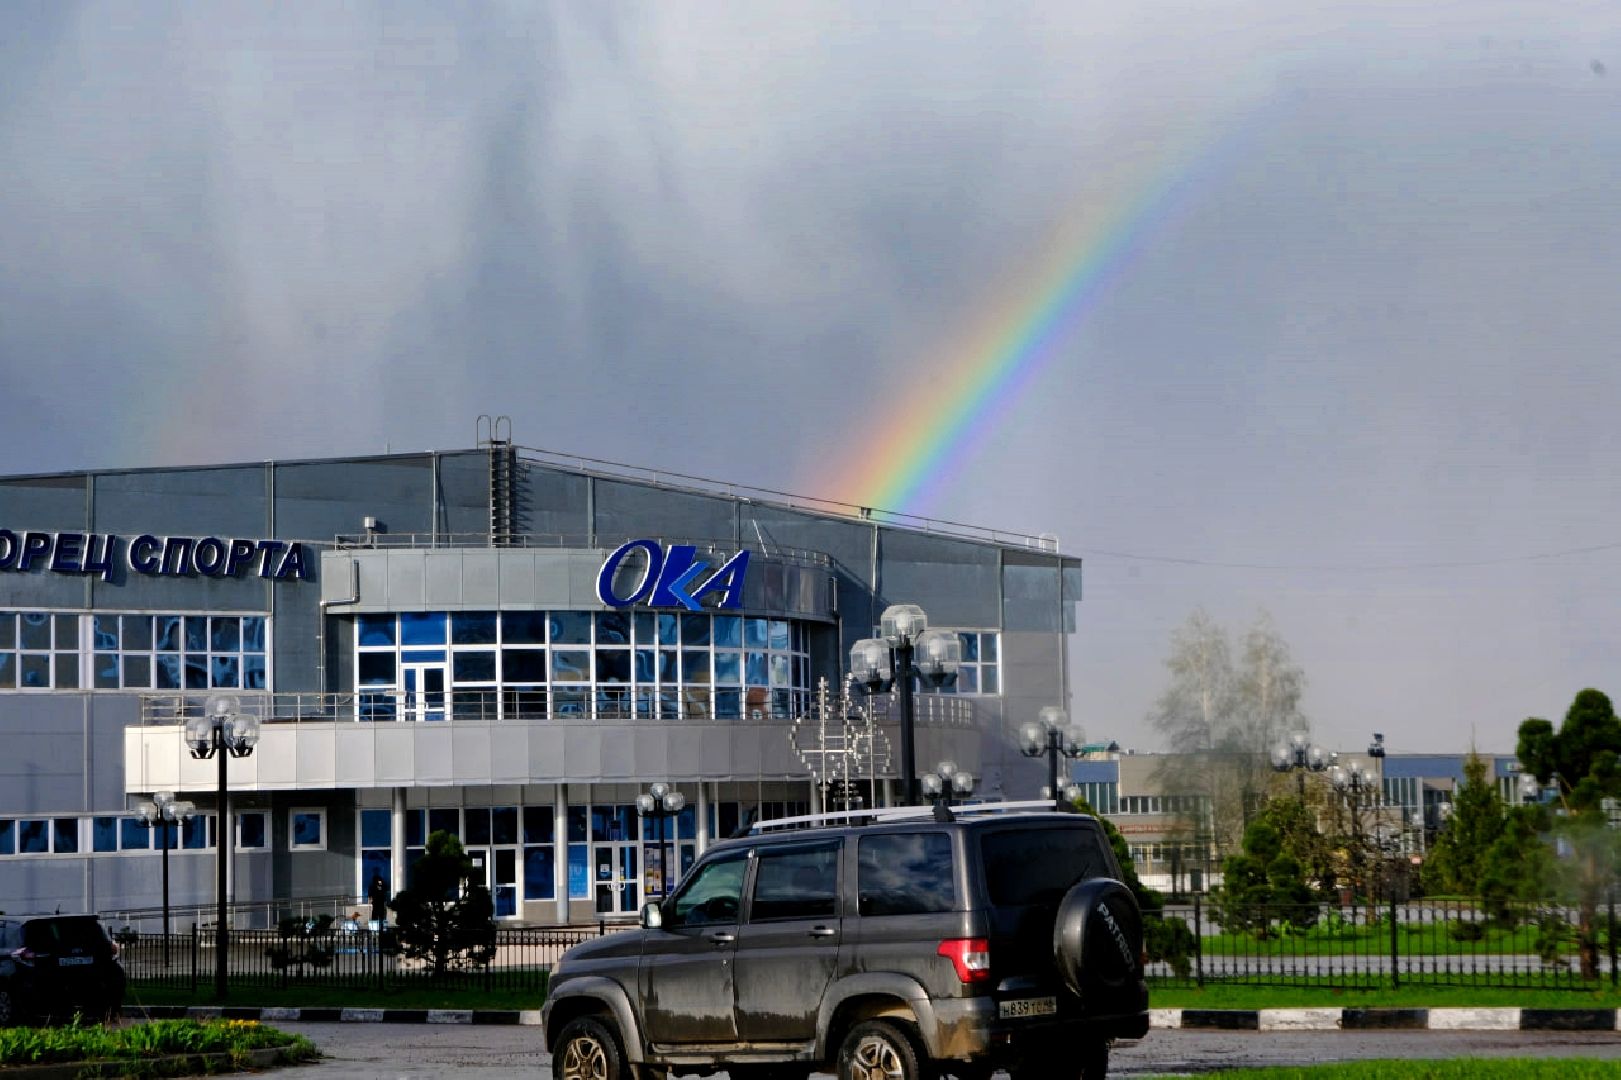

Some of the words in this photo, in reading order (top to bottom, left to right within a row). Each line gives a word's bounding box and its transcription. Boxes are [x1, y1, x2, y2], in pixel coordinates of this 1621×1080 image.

[127, 534, 306, 578] СПОРТА
[596, 539, 750, 611] ОКА
[1097, 901, 1135, 973] PATRIOT
